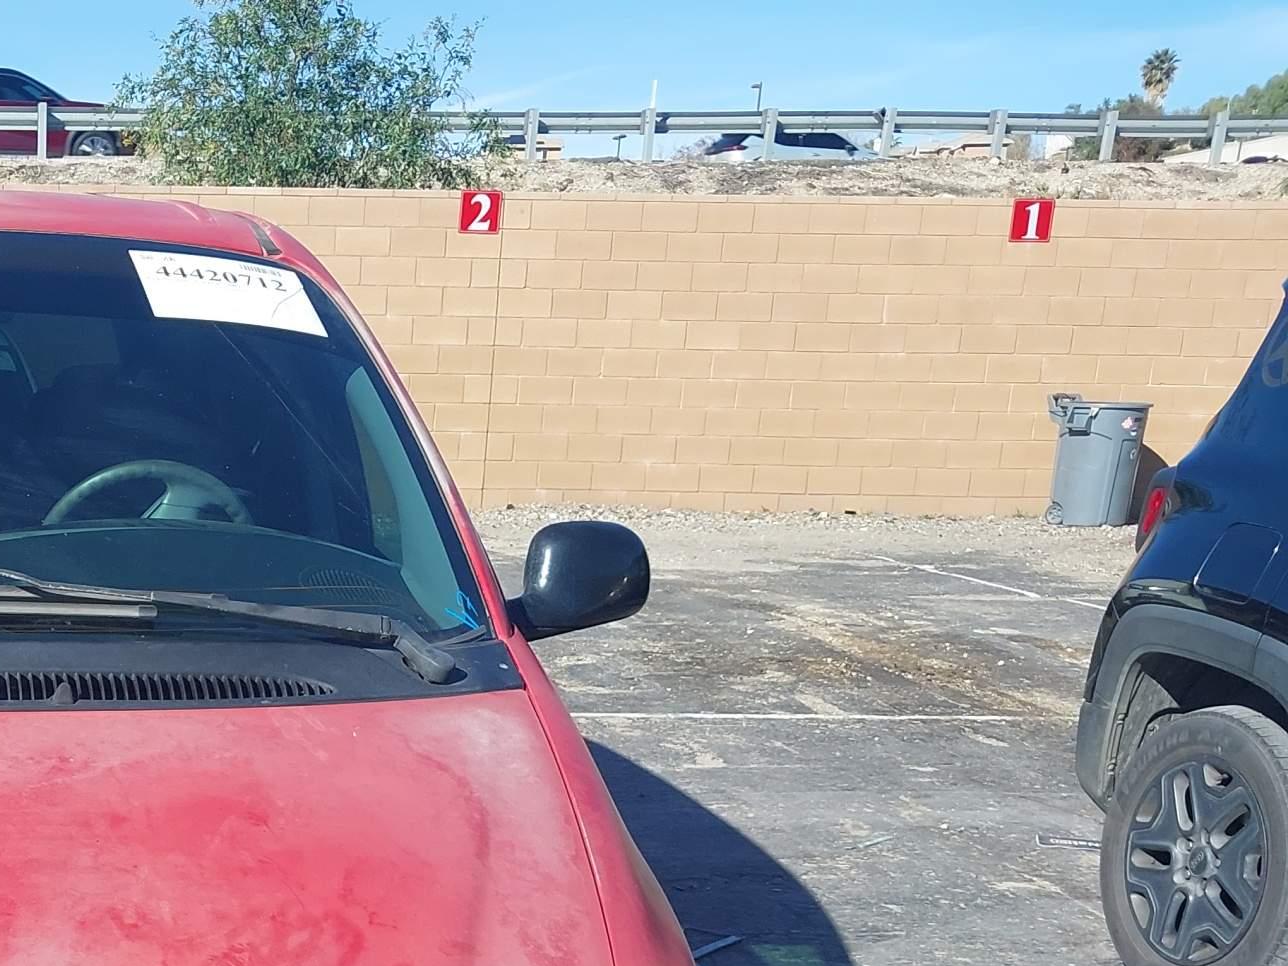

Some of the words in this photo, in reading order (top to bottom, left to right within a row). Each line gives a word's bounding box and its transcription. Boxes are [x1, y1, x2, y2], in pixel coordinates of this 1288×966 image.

[467, 193, 491, 231] 2
[1021, 202, 1040, 239] 1
[155, 265, 288, 292] 44420712
